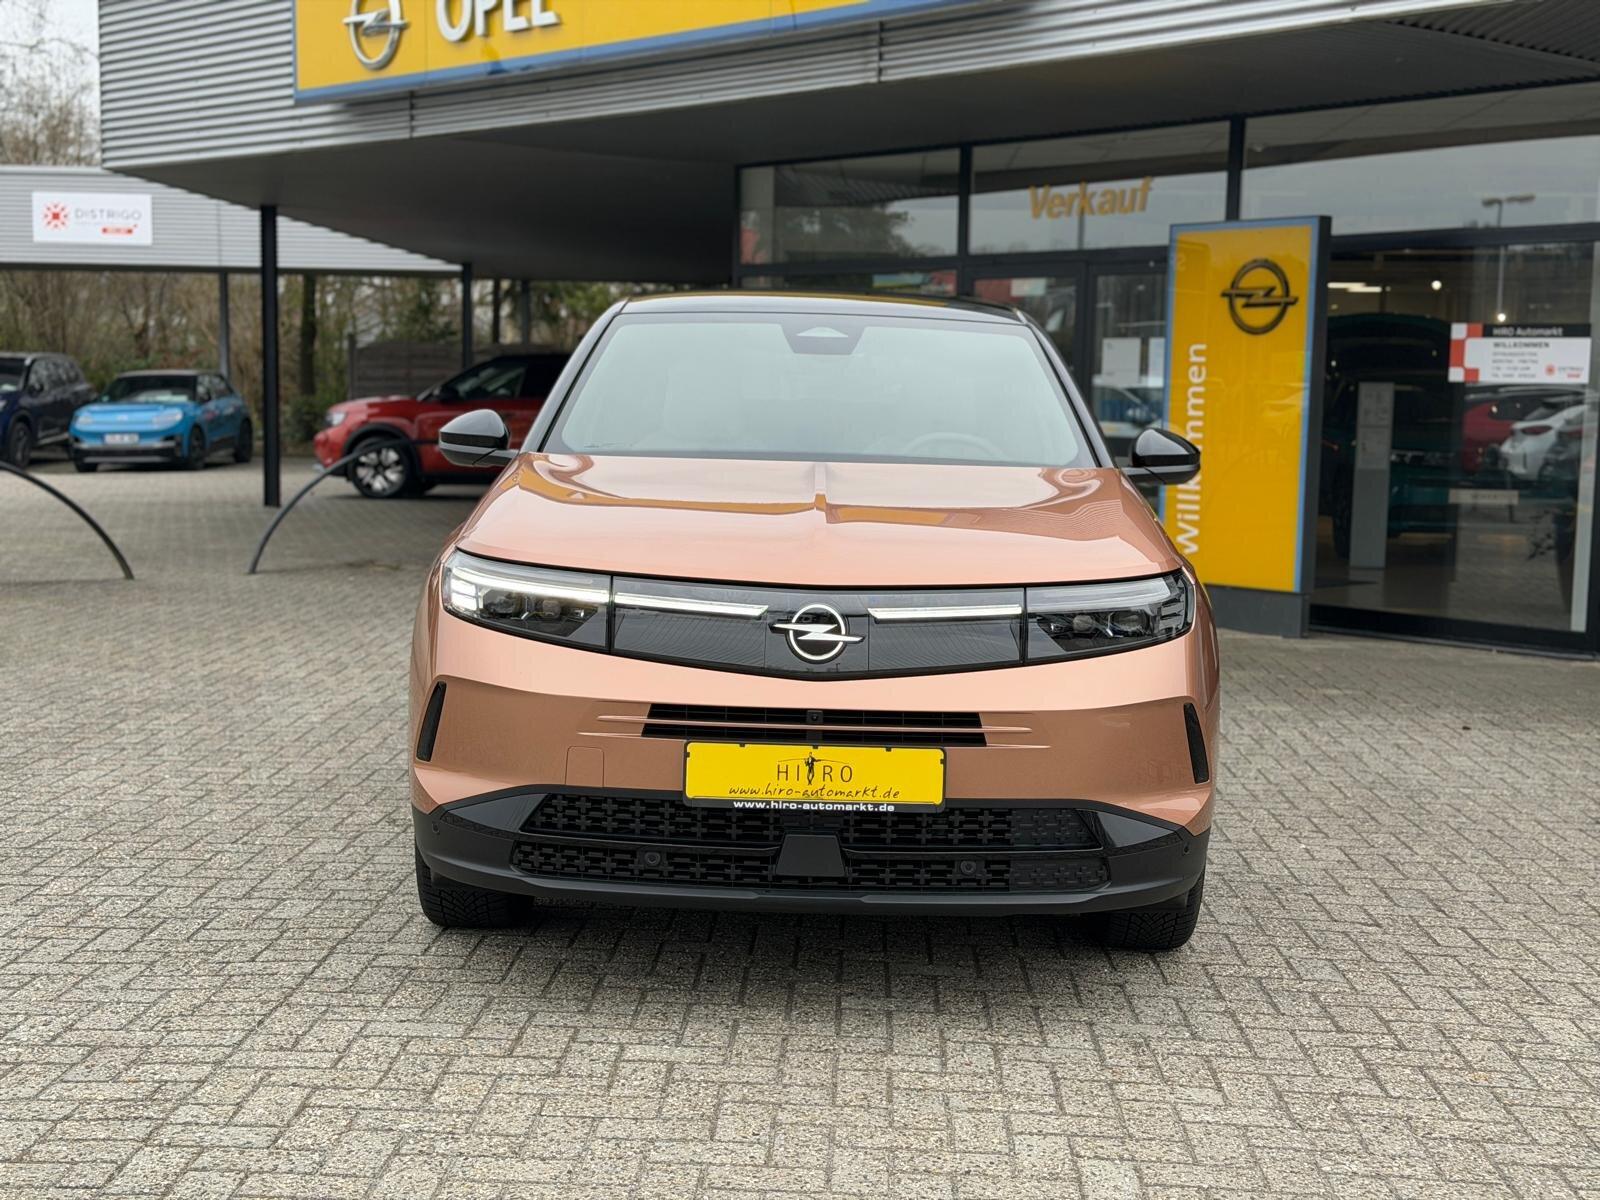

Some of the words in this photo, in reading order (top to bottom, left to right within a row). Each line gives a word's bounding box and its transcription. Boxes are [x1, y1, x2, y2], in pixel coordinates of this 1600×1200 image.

[1028, 176, 1153, 219] Verkauf
[75, 208, 142, 221] DISTRIGO
[1176, 343, 1208, 554] Willkmmen
[776, 764, 853, 783] HIRO
[728, 783, 900, 799] www.hiro-automarkt.de
[733, 801, 895, 812] www.hiro-automarkt.de
